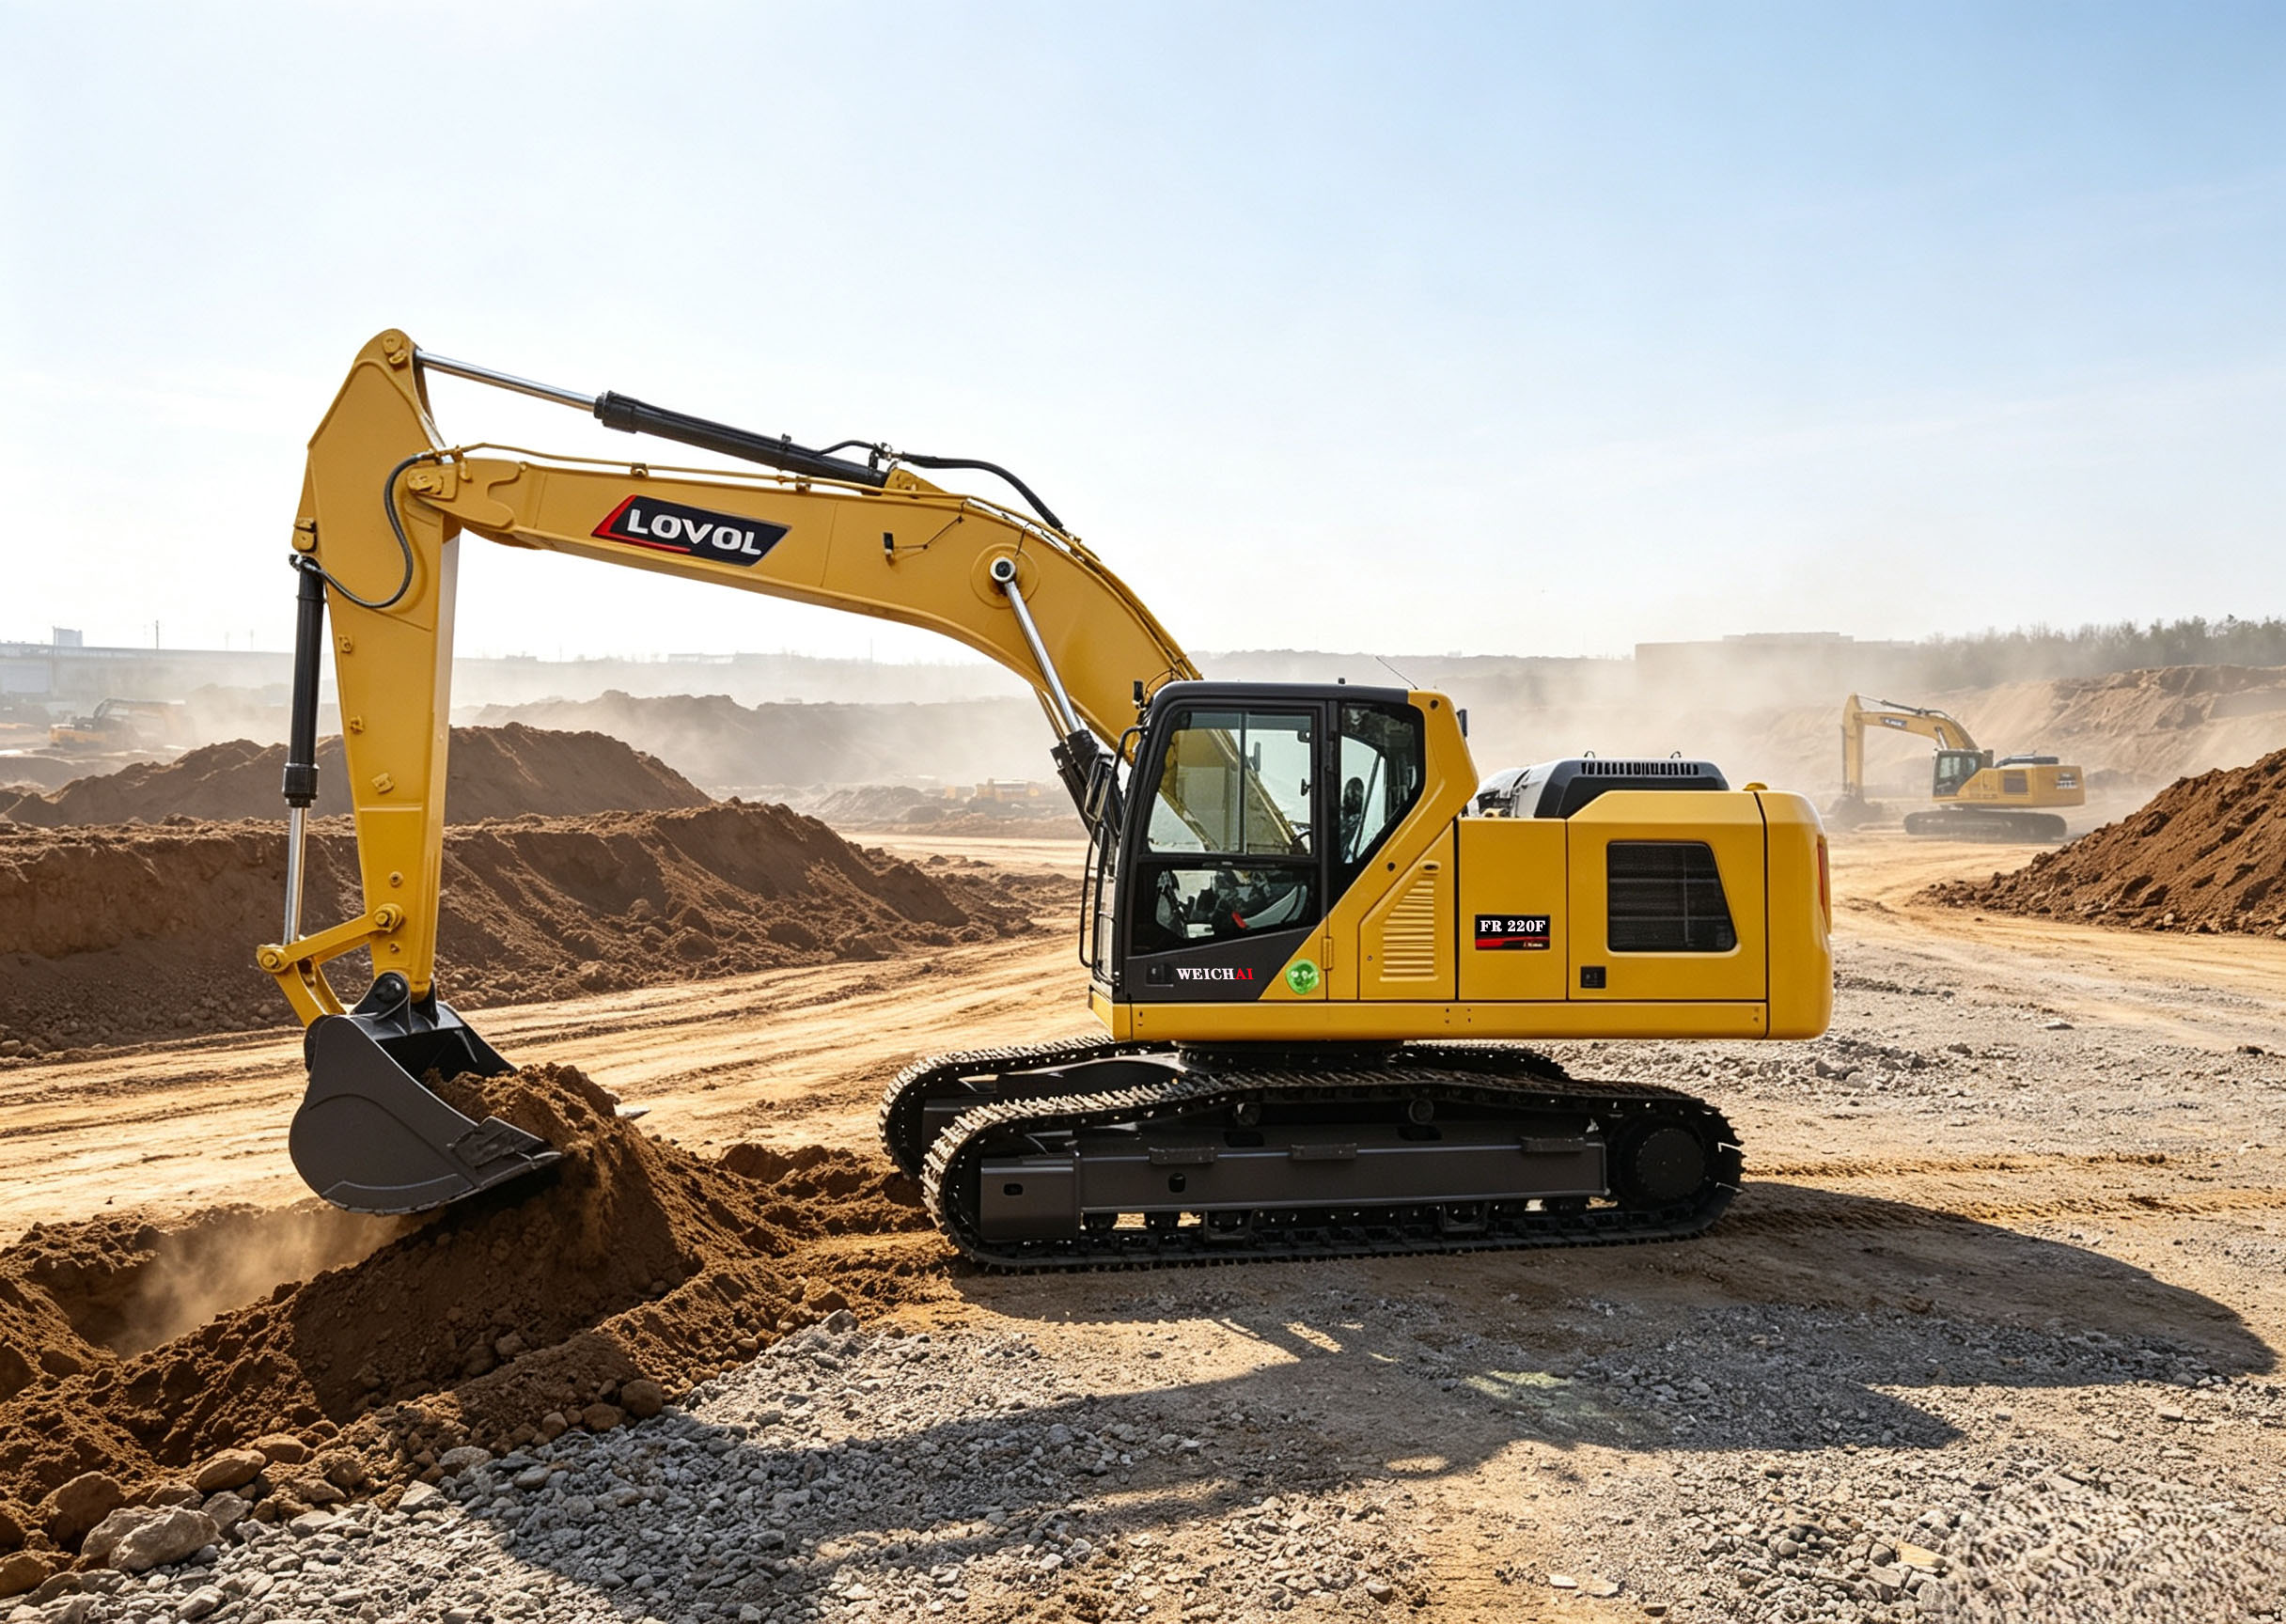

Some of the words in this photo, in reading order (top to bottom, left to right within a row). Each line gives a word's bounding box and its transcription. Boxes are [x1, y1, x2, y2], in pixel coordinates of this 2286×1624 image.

[627, 508, 762, 555] LOVOL
[1480, 919, 1502, 932] FR
[1507, 919, 1546, 932] 220F
[1175, 967, 1255, 980] WEICHAI
